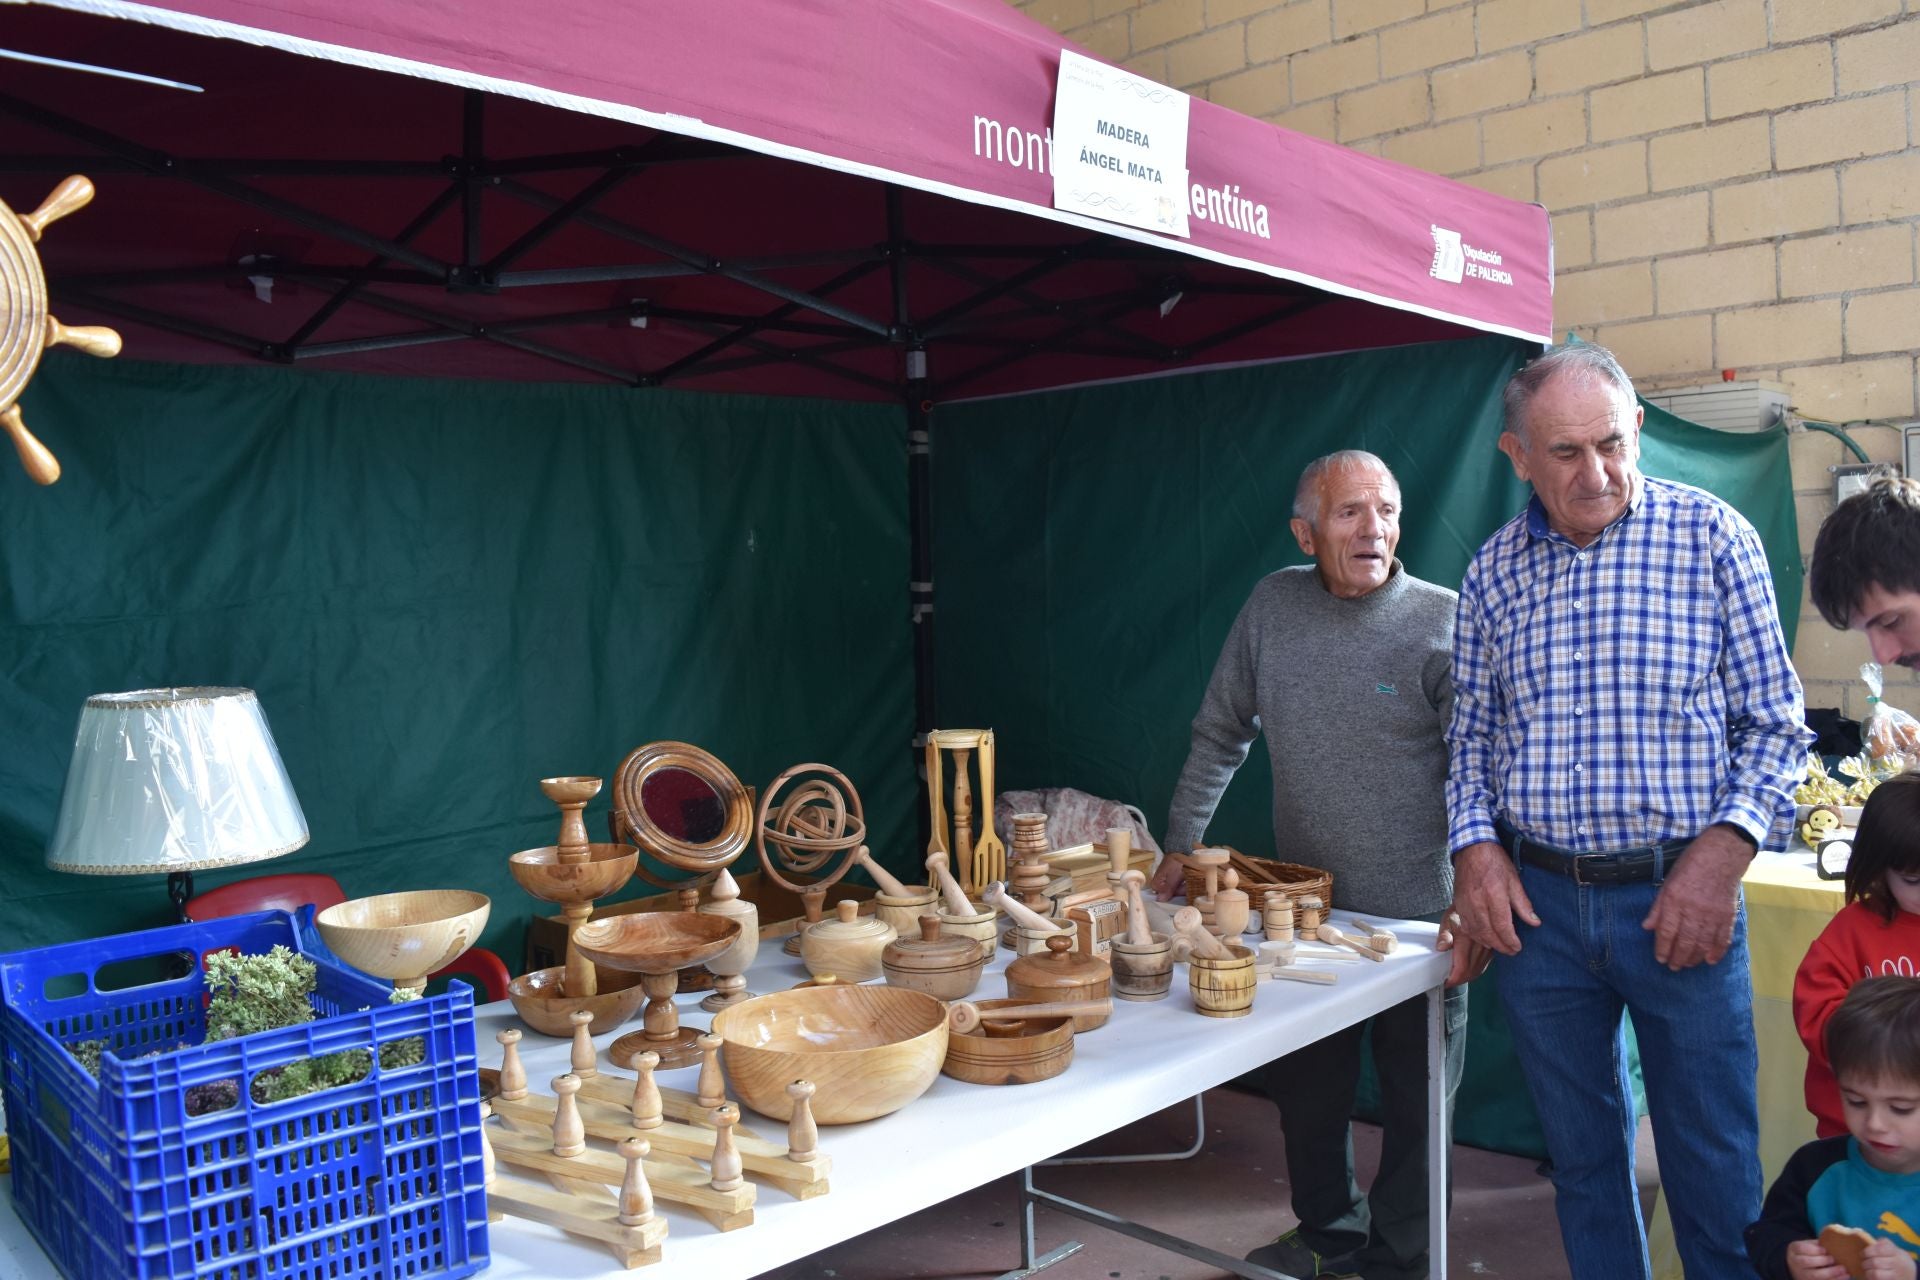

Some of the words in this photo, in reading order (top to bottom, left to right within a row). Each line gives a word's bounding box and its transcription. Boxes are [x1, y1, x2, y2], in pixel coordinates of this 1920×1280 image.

[974, 114, 1054, 177] mont
[1097, 119, 1149, 149] MADERA
[1079, 145, 1124, 174] ÁNGEL
[1127, 161, 1163, 184] MATA
[1190, 181, 1270, 239] entina
[1462, 243, 1502, 266] Diputación
[1466, 263, 1477, 277] DE
[1478, 266, 1513, 286] PALENCIA
